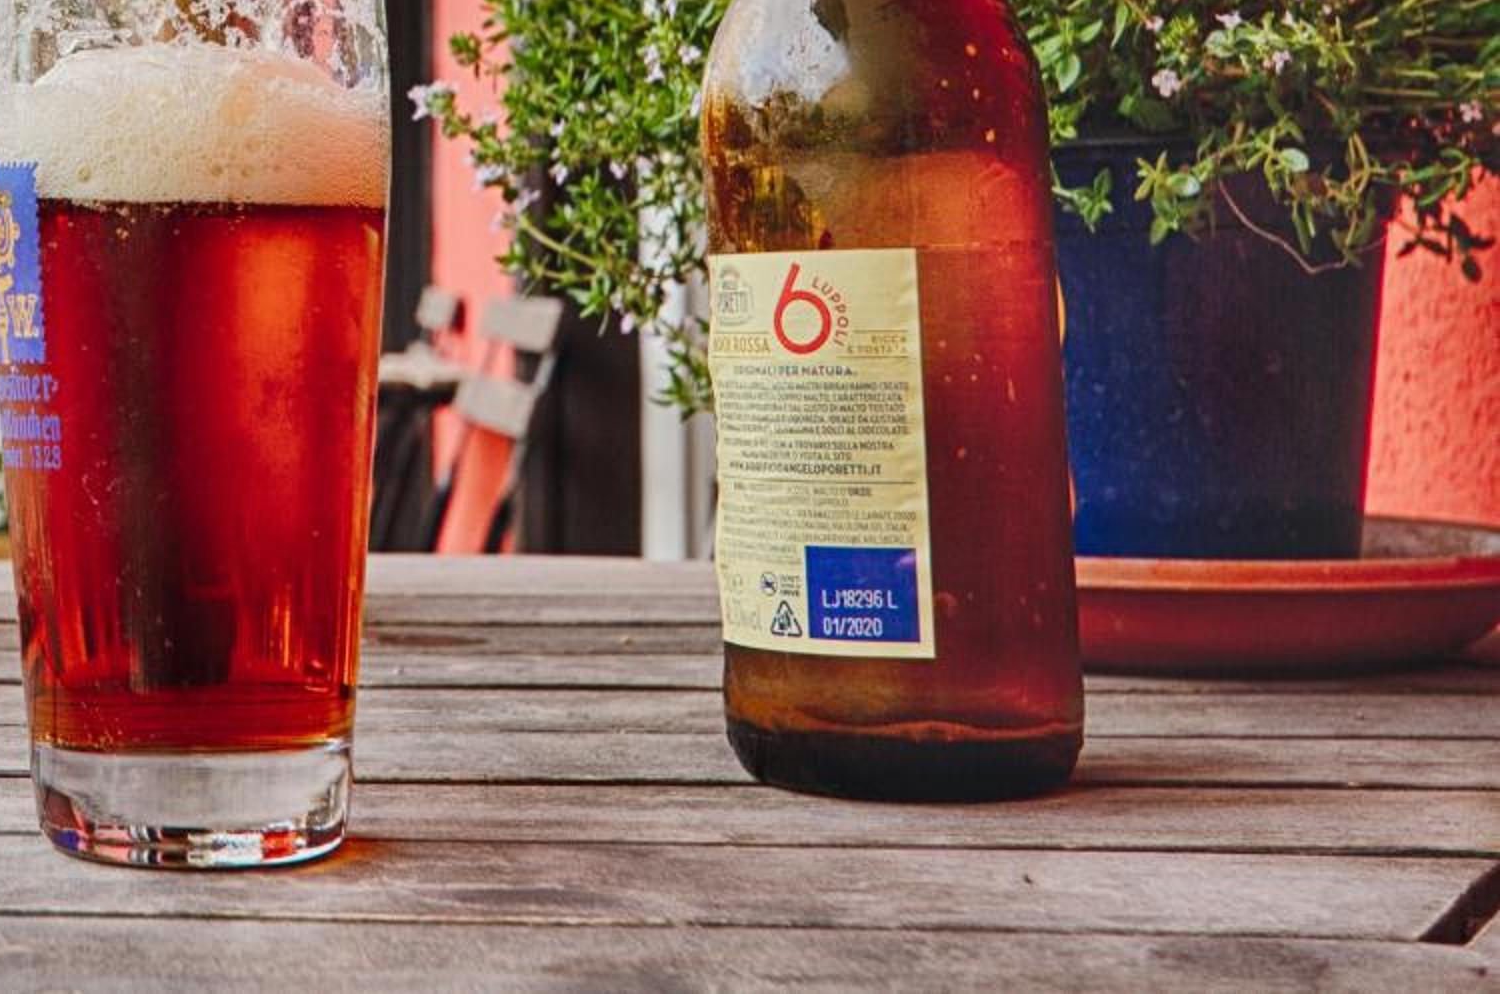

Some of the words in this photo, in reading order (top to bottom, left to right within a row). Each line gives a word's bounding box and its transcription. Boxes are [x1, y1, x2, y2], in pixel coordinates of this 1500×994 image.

[773, 262, 833, 355] 6
[811, 276, 850, 347] LUPPOLI
[821, 588, 883, 610] LJ18296
[887, 589, 899, 609] L
[822, 616, 883, 637] 01/2020
